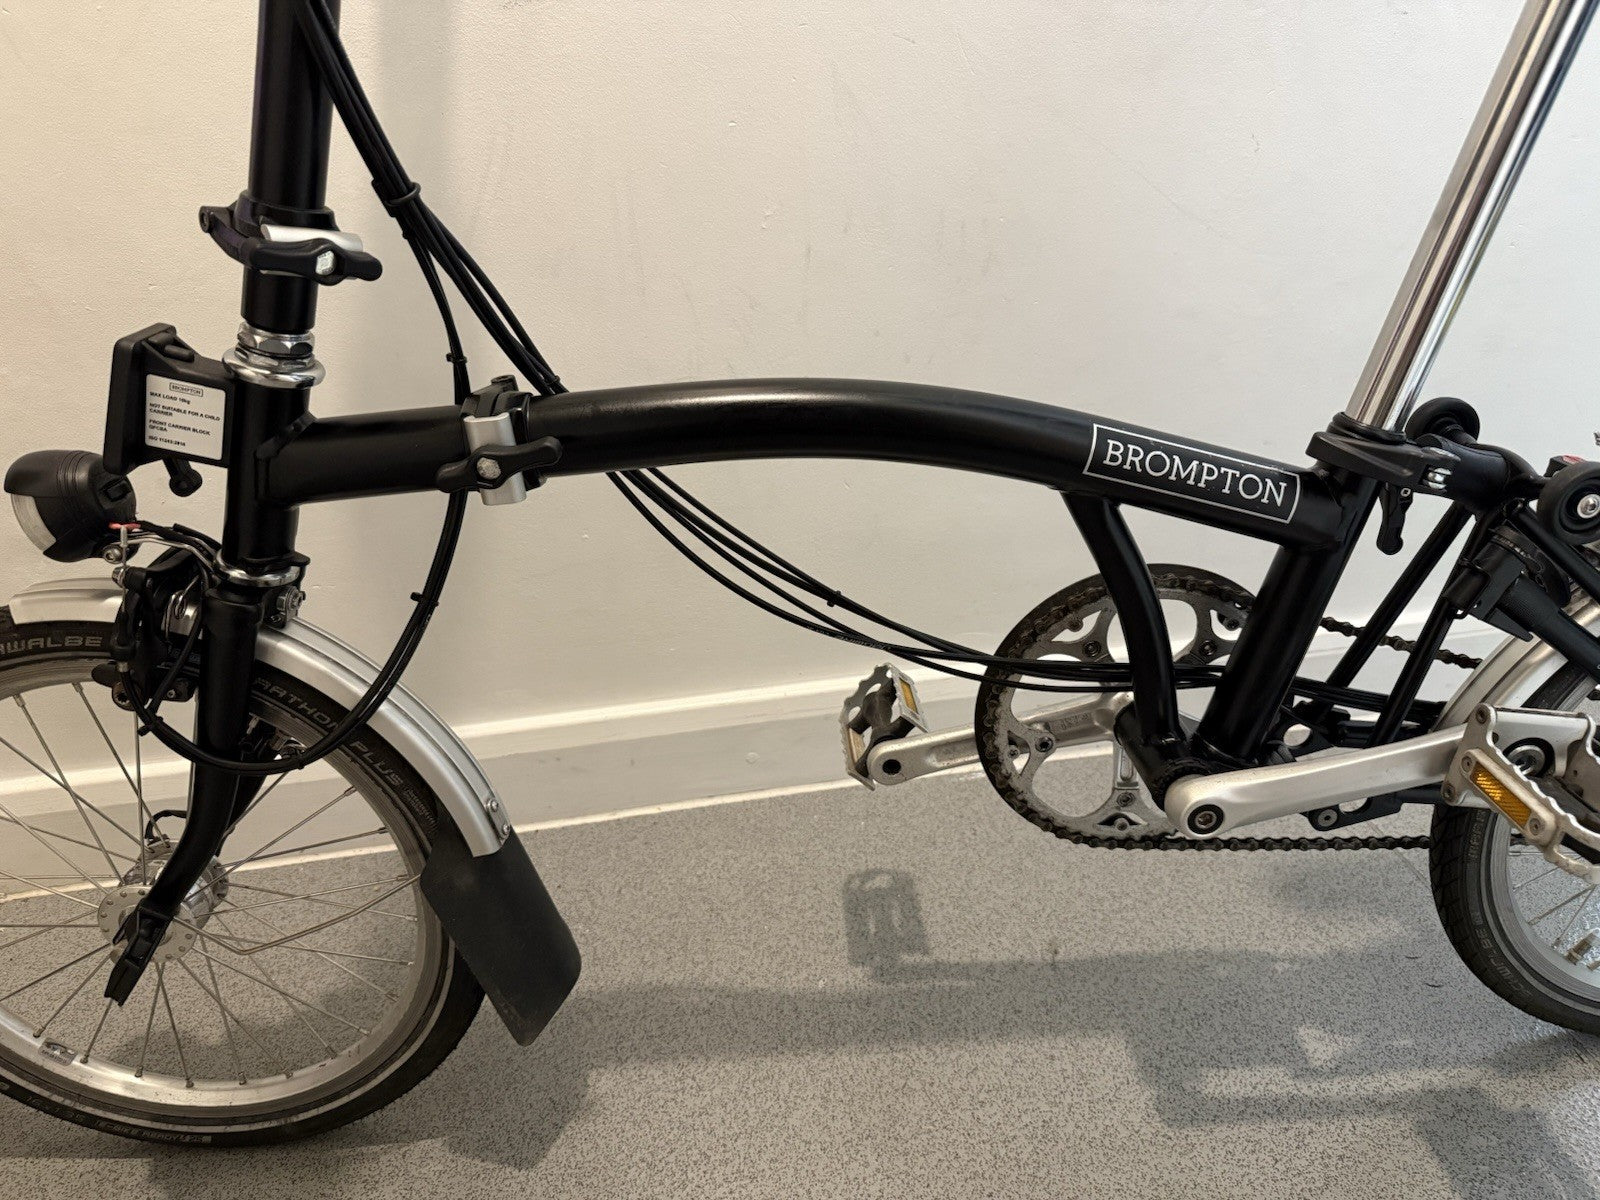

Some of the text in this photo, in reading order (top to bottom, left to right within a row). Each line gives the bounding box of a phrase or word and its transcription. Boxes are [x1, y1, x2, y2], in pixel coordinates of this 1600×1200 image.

[149, 408, 172, 416] CARRIER
[162, 405, 187, 414] SUITABLE
[204, 413, 220, 421] CHILD
[167, 422, 190, 430] CARRIER
[1102, 438, 1287, 508] BROMPTON
[350, 740, 403, 786] PLUS
